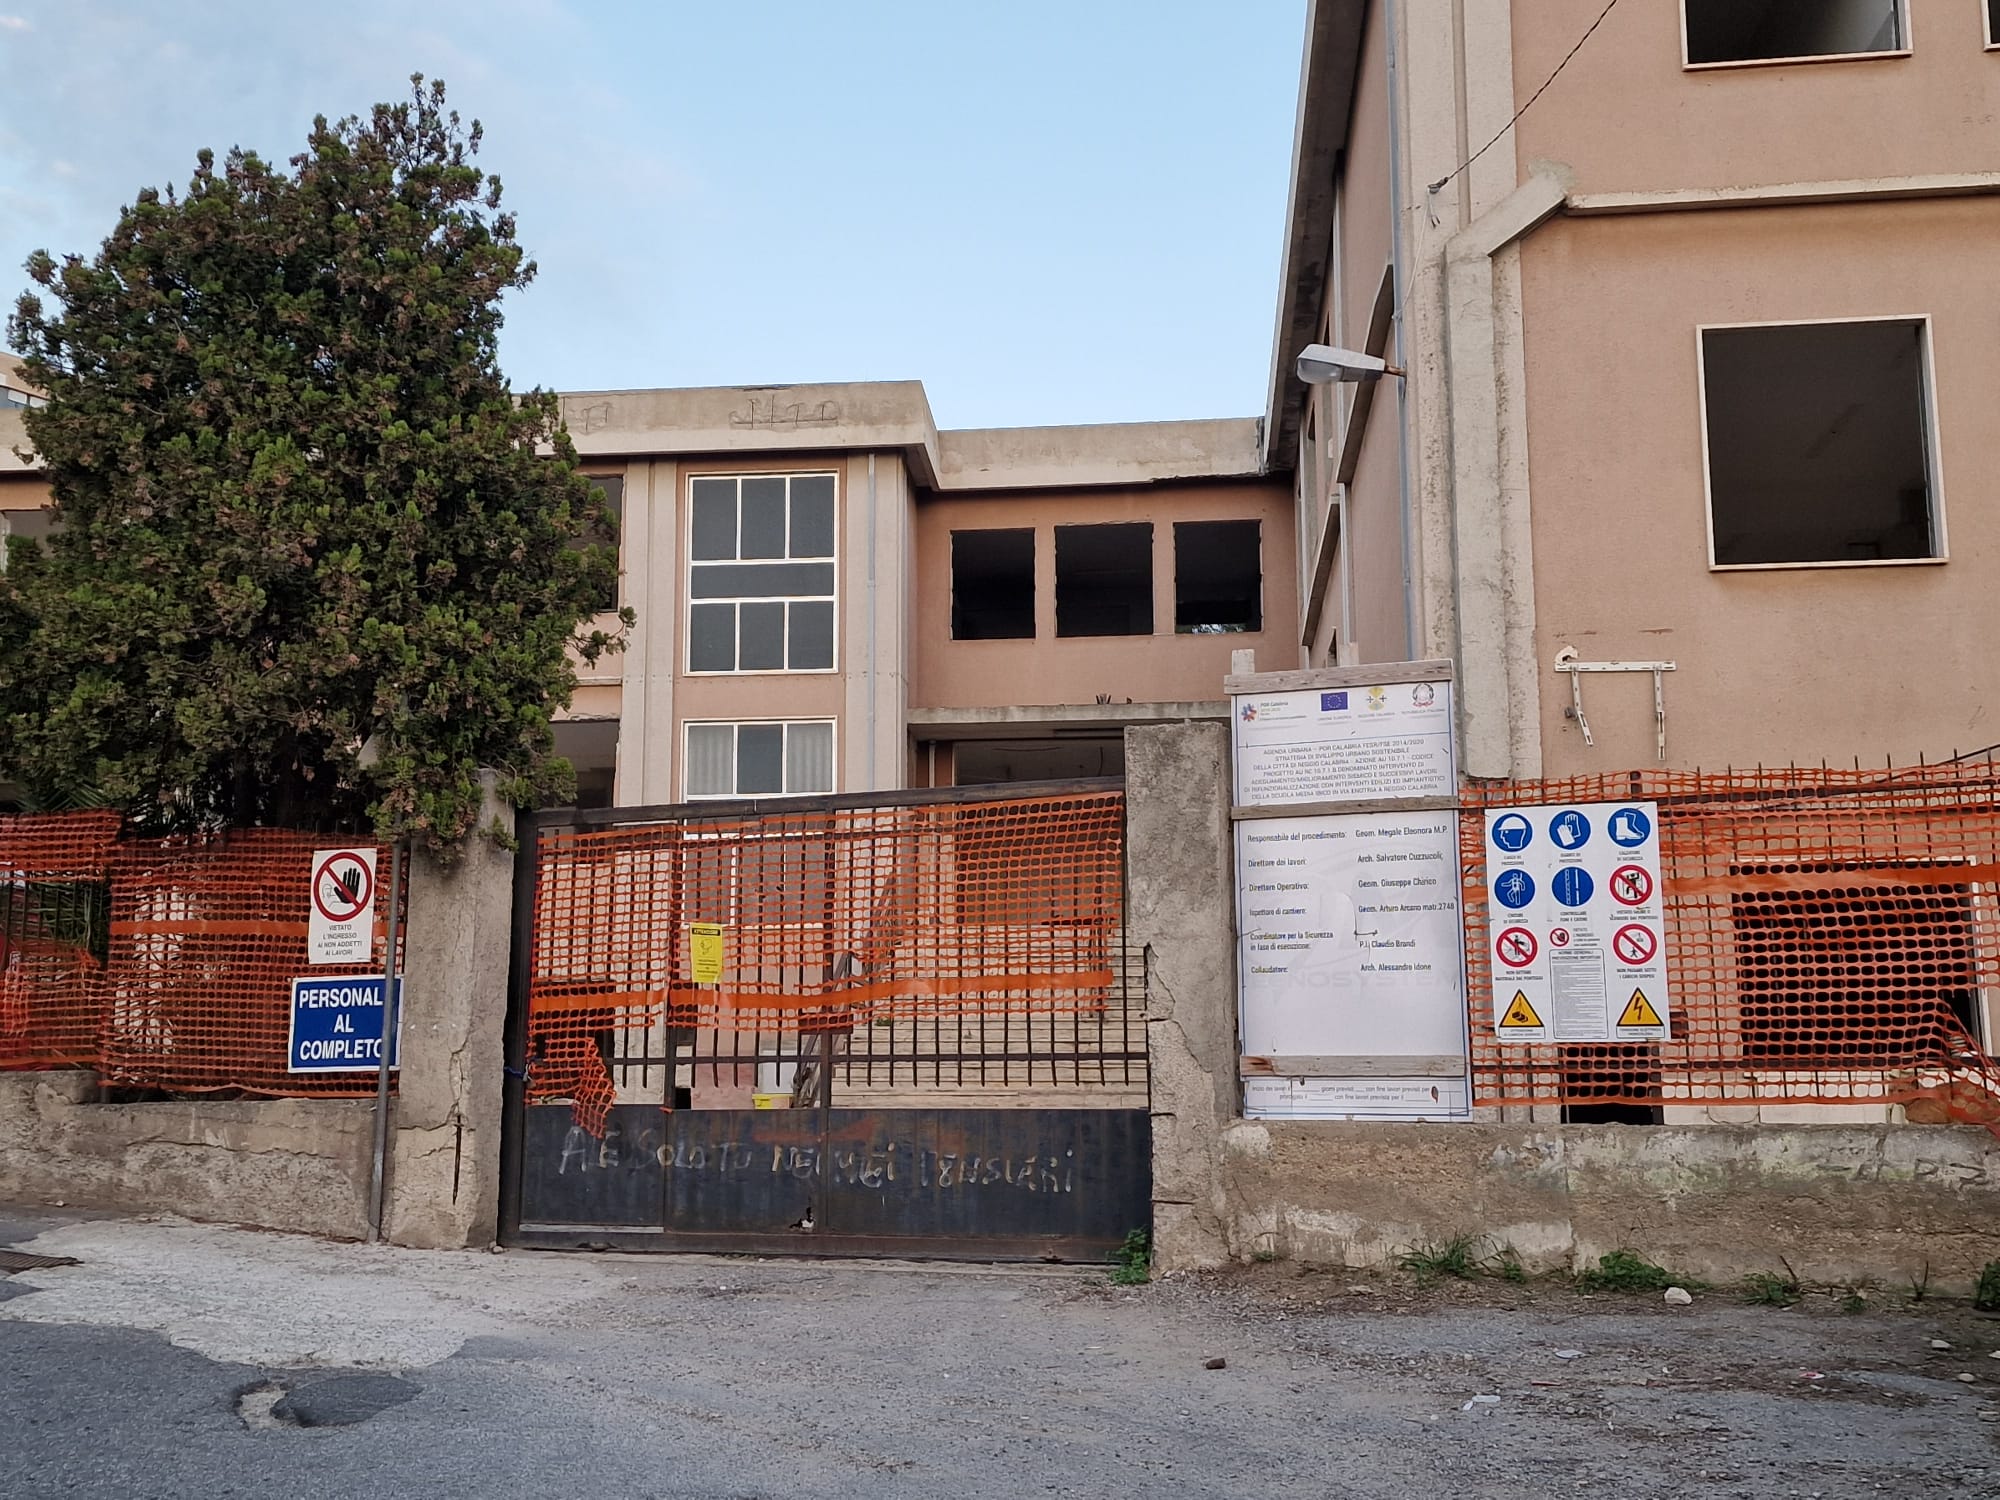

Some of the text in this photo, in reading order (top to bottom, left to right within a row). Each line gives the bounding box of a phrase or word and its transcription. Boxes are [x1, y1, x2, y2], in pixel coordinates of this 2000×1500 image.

[1372, 747, 1409, 755] SOSTENIBILE
[1338, 764, 1377, 772] DENOMINATO
[1379, 762, 1416, 770] INTERVENTO
[1248, 832, 1289, 843] Responsabile
[1378, 828, 1402, 838] Megale
[1404, 827, 1432, 835] Eleonora
[1248, 859, 1275, 867] Direttore
[1276, 858, 1286, 866] dei
[1358, 855, 1374, 863] Arch.
[1376, 853, 1407, 862] Salvatore
[1249, 884, 1275, 892] Direttore
[1358, 880, 1378, 888] Geom.
[1381, 879, 1411, 888] Giuseppe
[1413, 877, 1437, 886] Chirico
[1250, 908, 1274, 916] Ispettore
[1380, 904, 1398, 912] Arturo
[1298, 931, 1303, 939] la
[1305, 931, 1333, 939] Sicurezza
[1371, 939, 1395, 948] Claudio
[1396, 939, 1416, 948] Brandi
[1361, 963, 1377, 971] Arch.
[1379, 963, 1413, 971] Alessandro
[300, 987, 384, 1009] PERSONAL
[334, 1014, 355, 1033] AL
